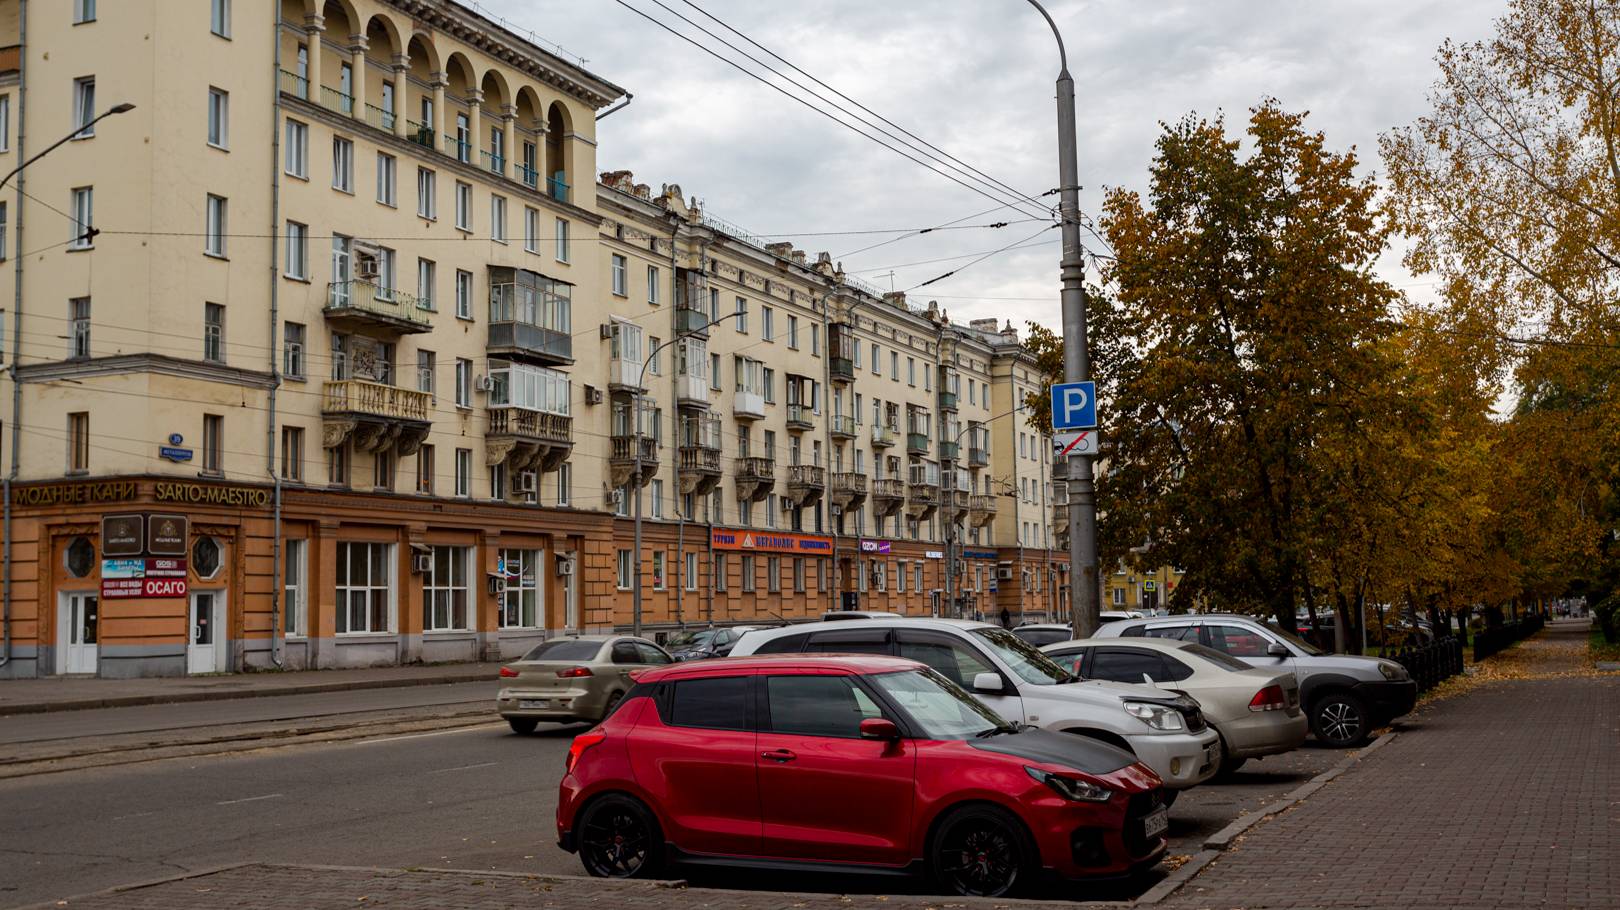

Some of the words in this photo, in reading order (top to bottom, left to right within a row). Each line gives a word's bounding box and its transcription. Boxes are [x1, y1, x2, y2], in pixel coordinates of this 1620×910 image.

[1063, 388, 1087, 423] P
[16, 487, 83, 505] МОДНЫЕ
[87, 483, 137, 500] ТКАНИ
[156, 483, 267, 506] SARTO-MAESTRO
[862, 541, 878, 551] OZON
[146, 581, 186, 594] ОСАГО
